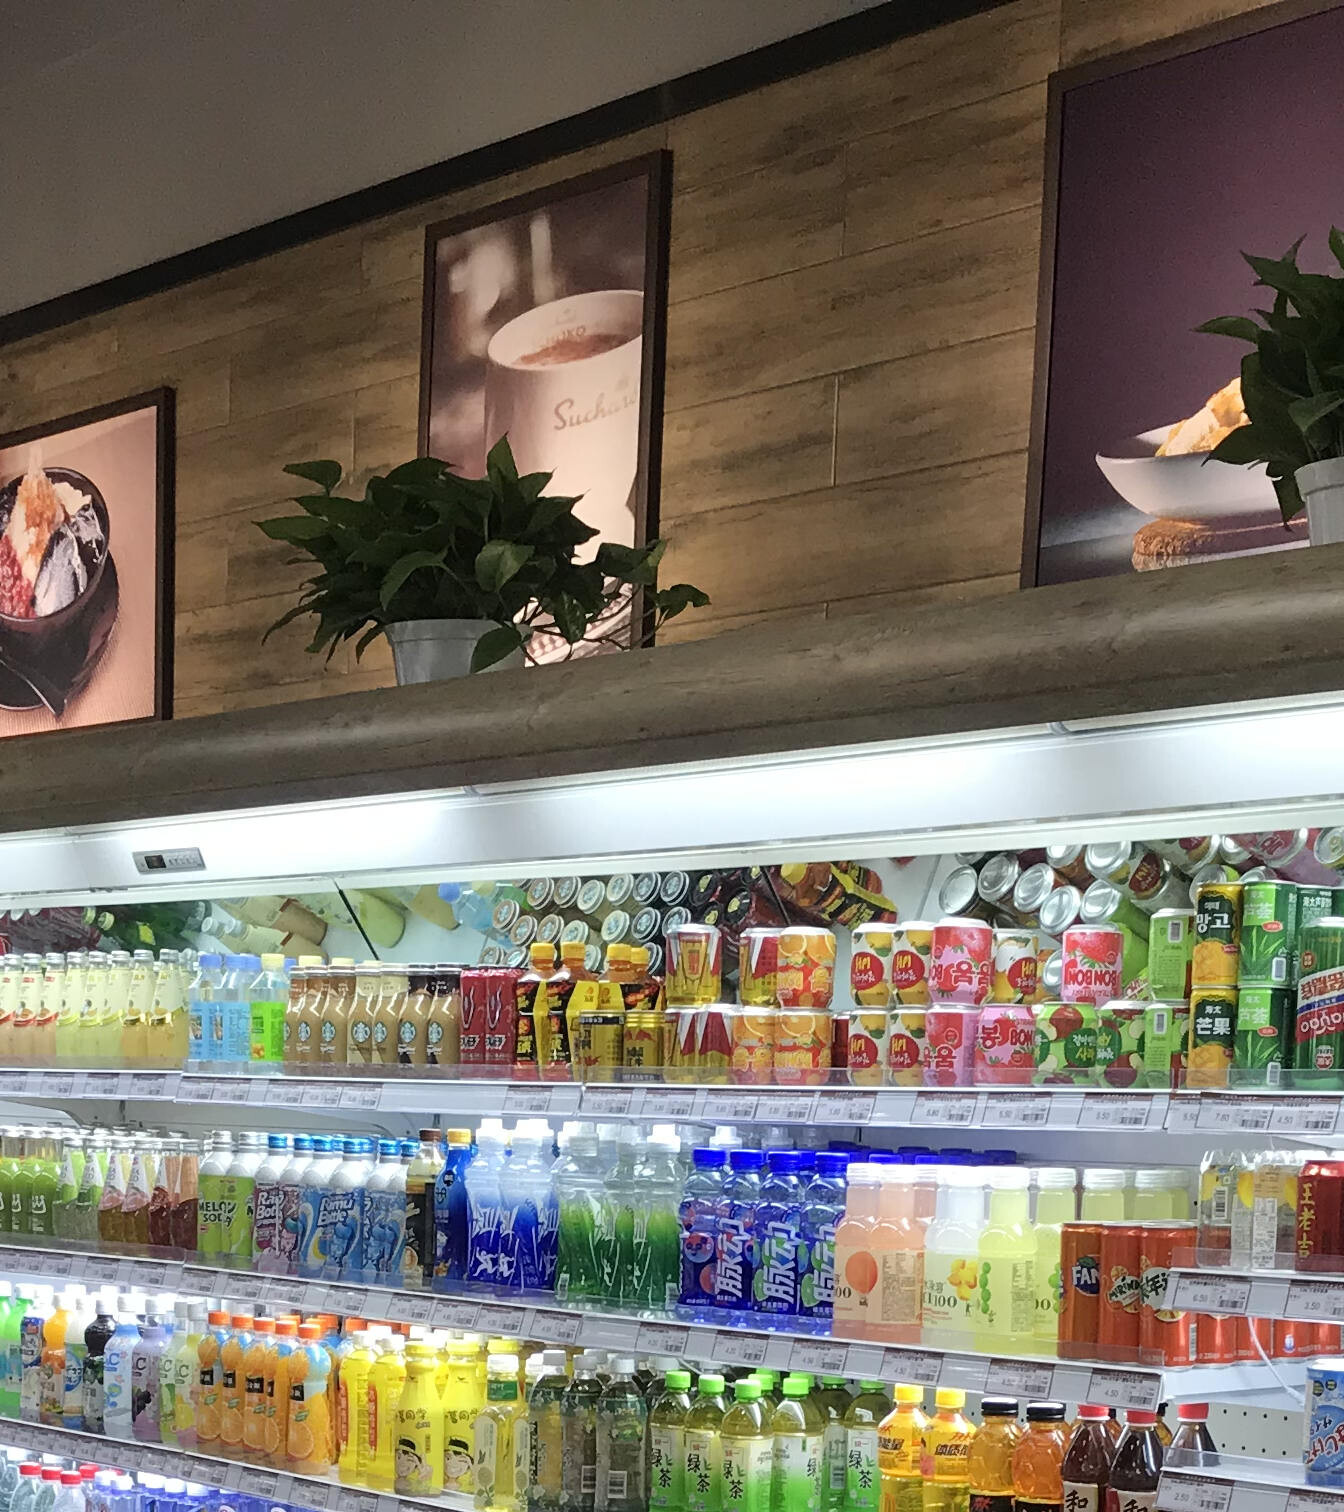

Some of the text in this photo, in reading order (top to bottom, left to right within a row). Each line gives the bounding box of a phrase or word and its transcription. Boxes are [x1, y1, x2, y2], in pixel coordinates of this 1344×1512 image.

[1196, 913, 1231, 934] 망고
[1195, 1017, 1231, 1036] 芒果
[1296, 1182, 1316, 1259] 王老吉
[716, 1217, 752, 1299] 脉动
[763, 1220, 810, 1305] 脉动
[687, 1453, 712, 1494] 绿茶
[848, 1449, 873, 1490] 绿茶
